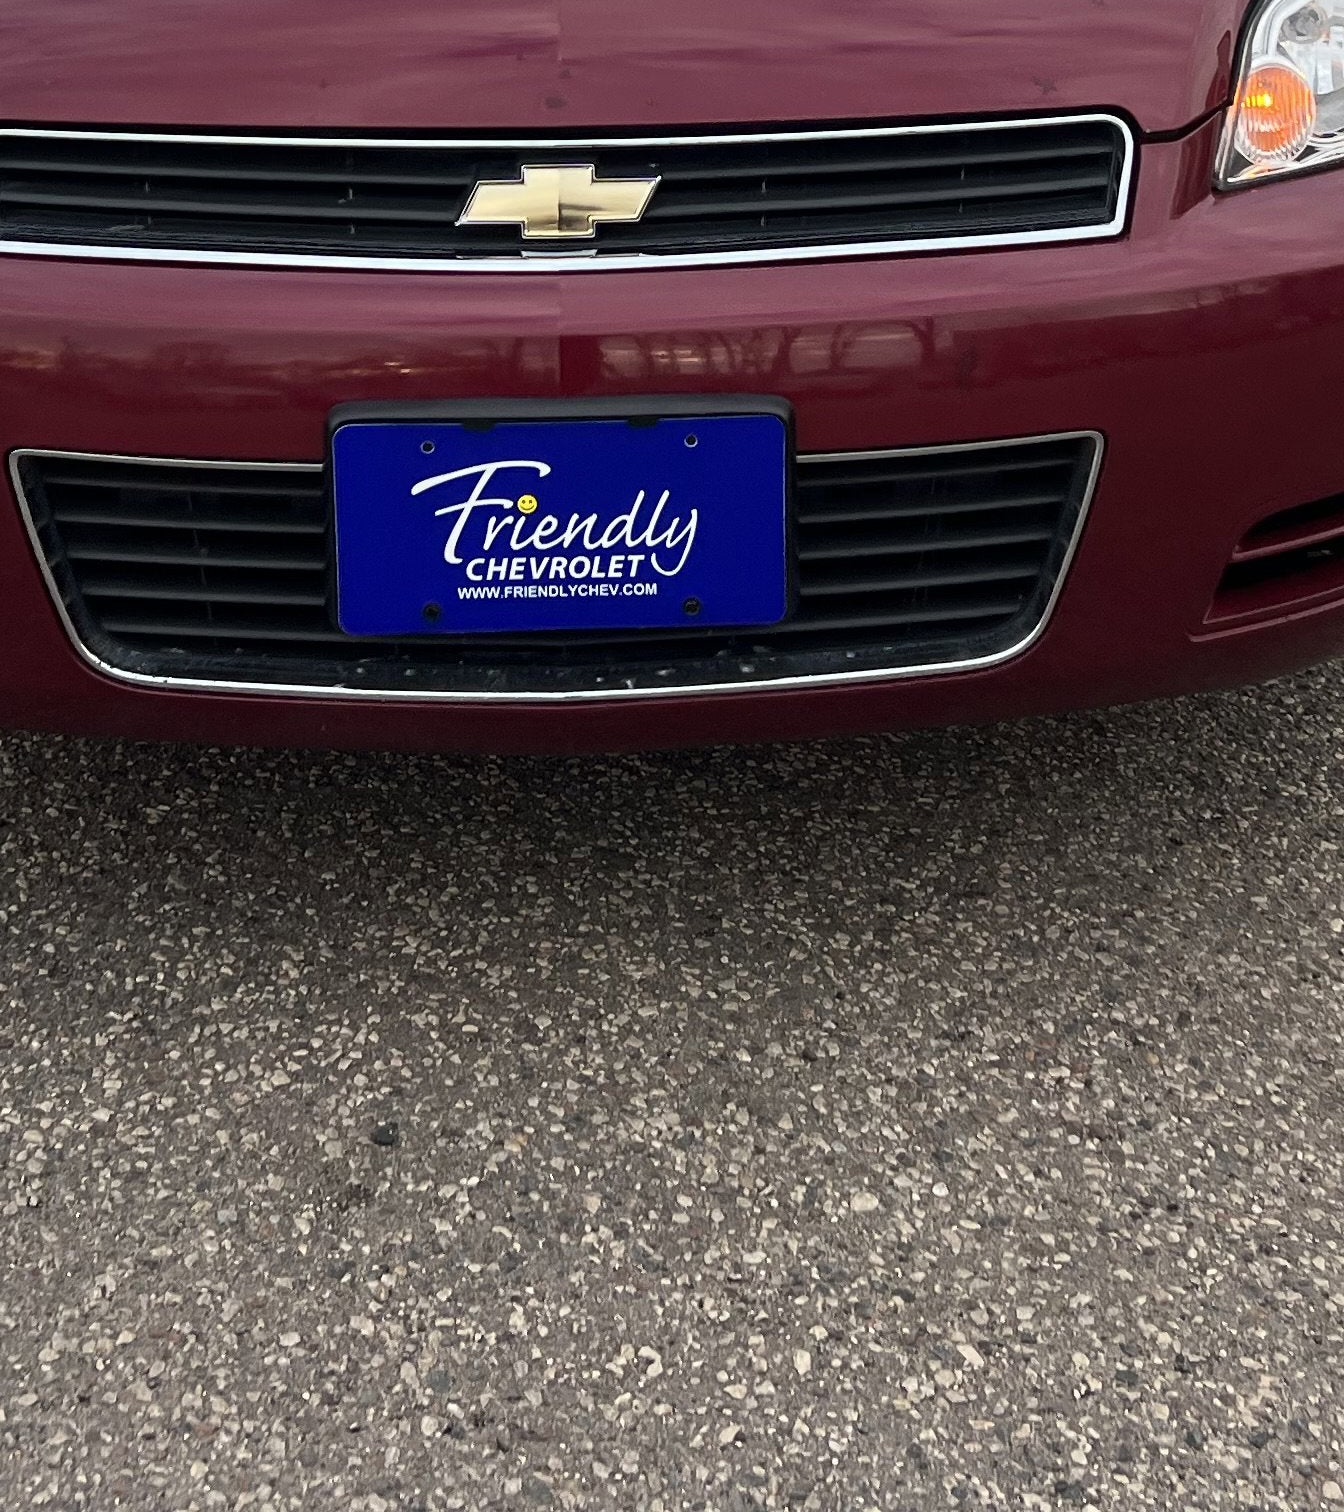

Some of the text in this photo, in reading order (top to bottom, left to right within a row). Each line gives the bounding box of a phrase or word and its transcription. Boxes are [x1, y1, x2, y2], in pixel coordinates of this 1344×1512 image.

[411, 460, 698, 576] Friendly
[466, 554, 645, 581] CHEVROLET
[457, 583, 658, 599] WWW.FRIENDLYCHEV.COM
